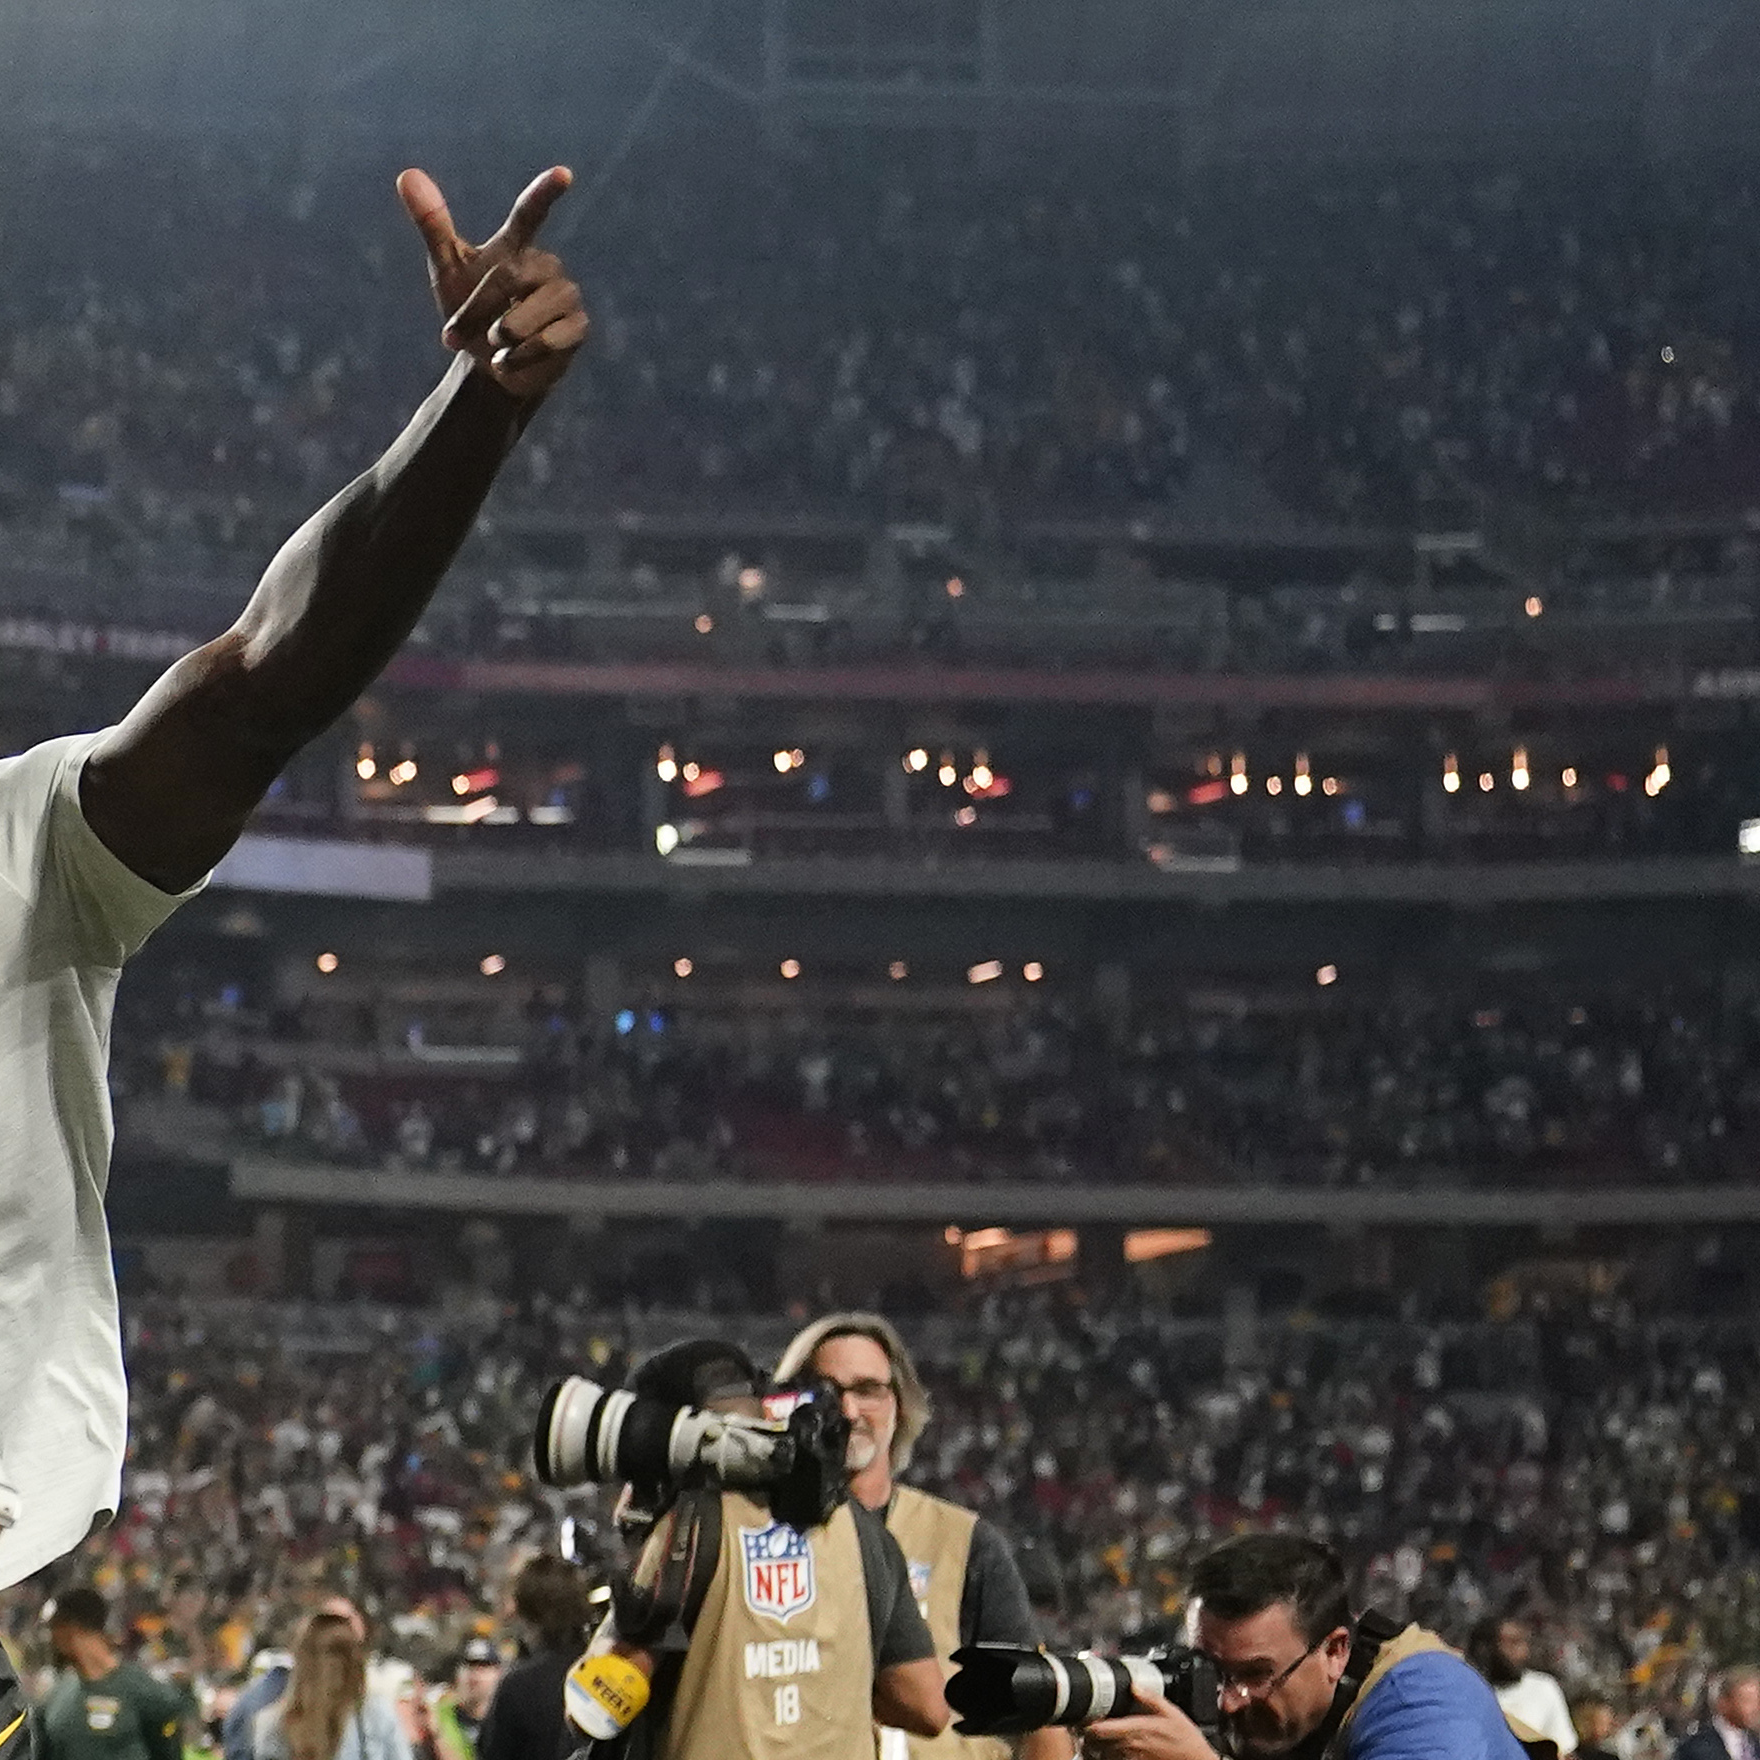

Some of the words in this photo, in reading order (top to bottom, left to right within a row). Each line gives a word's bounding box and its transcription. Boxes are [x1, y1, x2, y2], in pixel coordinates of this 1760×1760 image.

[753, 1560, 806, 1606] NFL
[744, 1637, 821, 1680] MEDIA
[773, 1683, 801, 1727] 18
